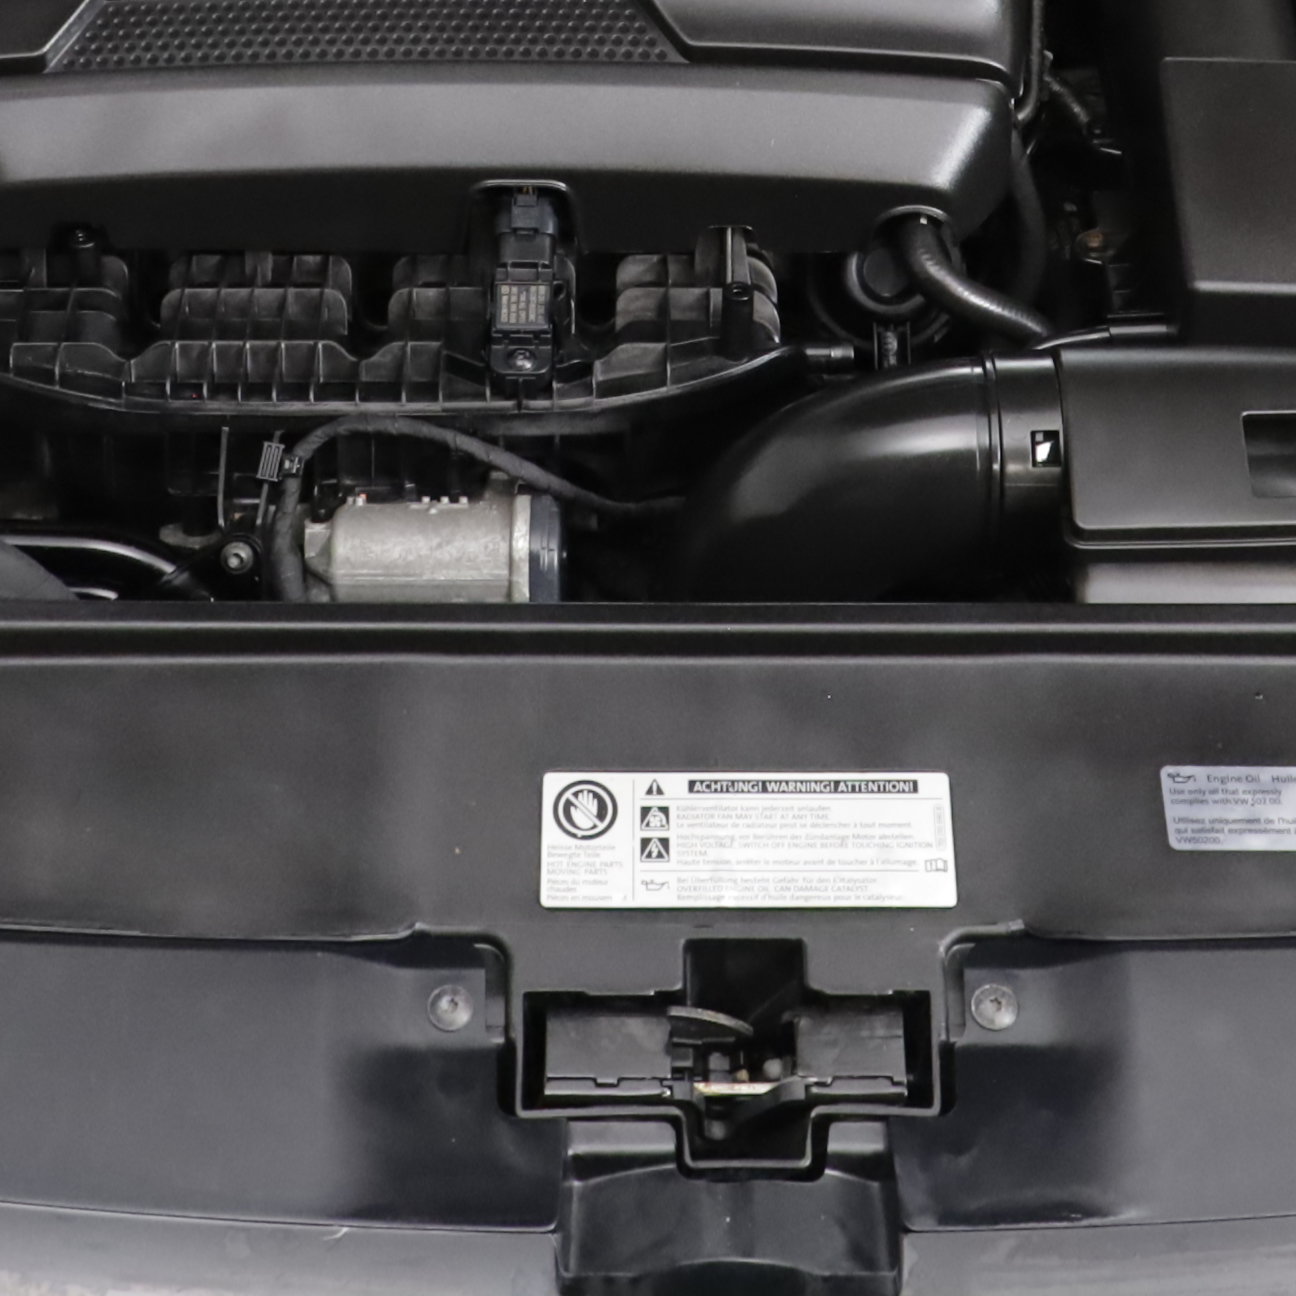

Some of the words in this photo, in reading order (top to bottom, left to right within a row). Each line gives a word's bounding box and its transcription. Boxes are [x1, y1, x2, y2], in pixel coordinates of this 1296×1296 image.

[1207, 774, 1243, 785] Engine
[1245, 774, 1260, 783] Oil
[693, 781, 762, 793] ACHTUNG!
[765, 781, 834, 793] WARNING!
[837, 781, 914, 793] ATTENTION!
